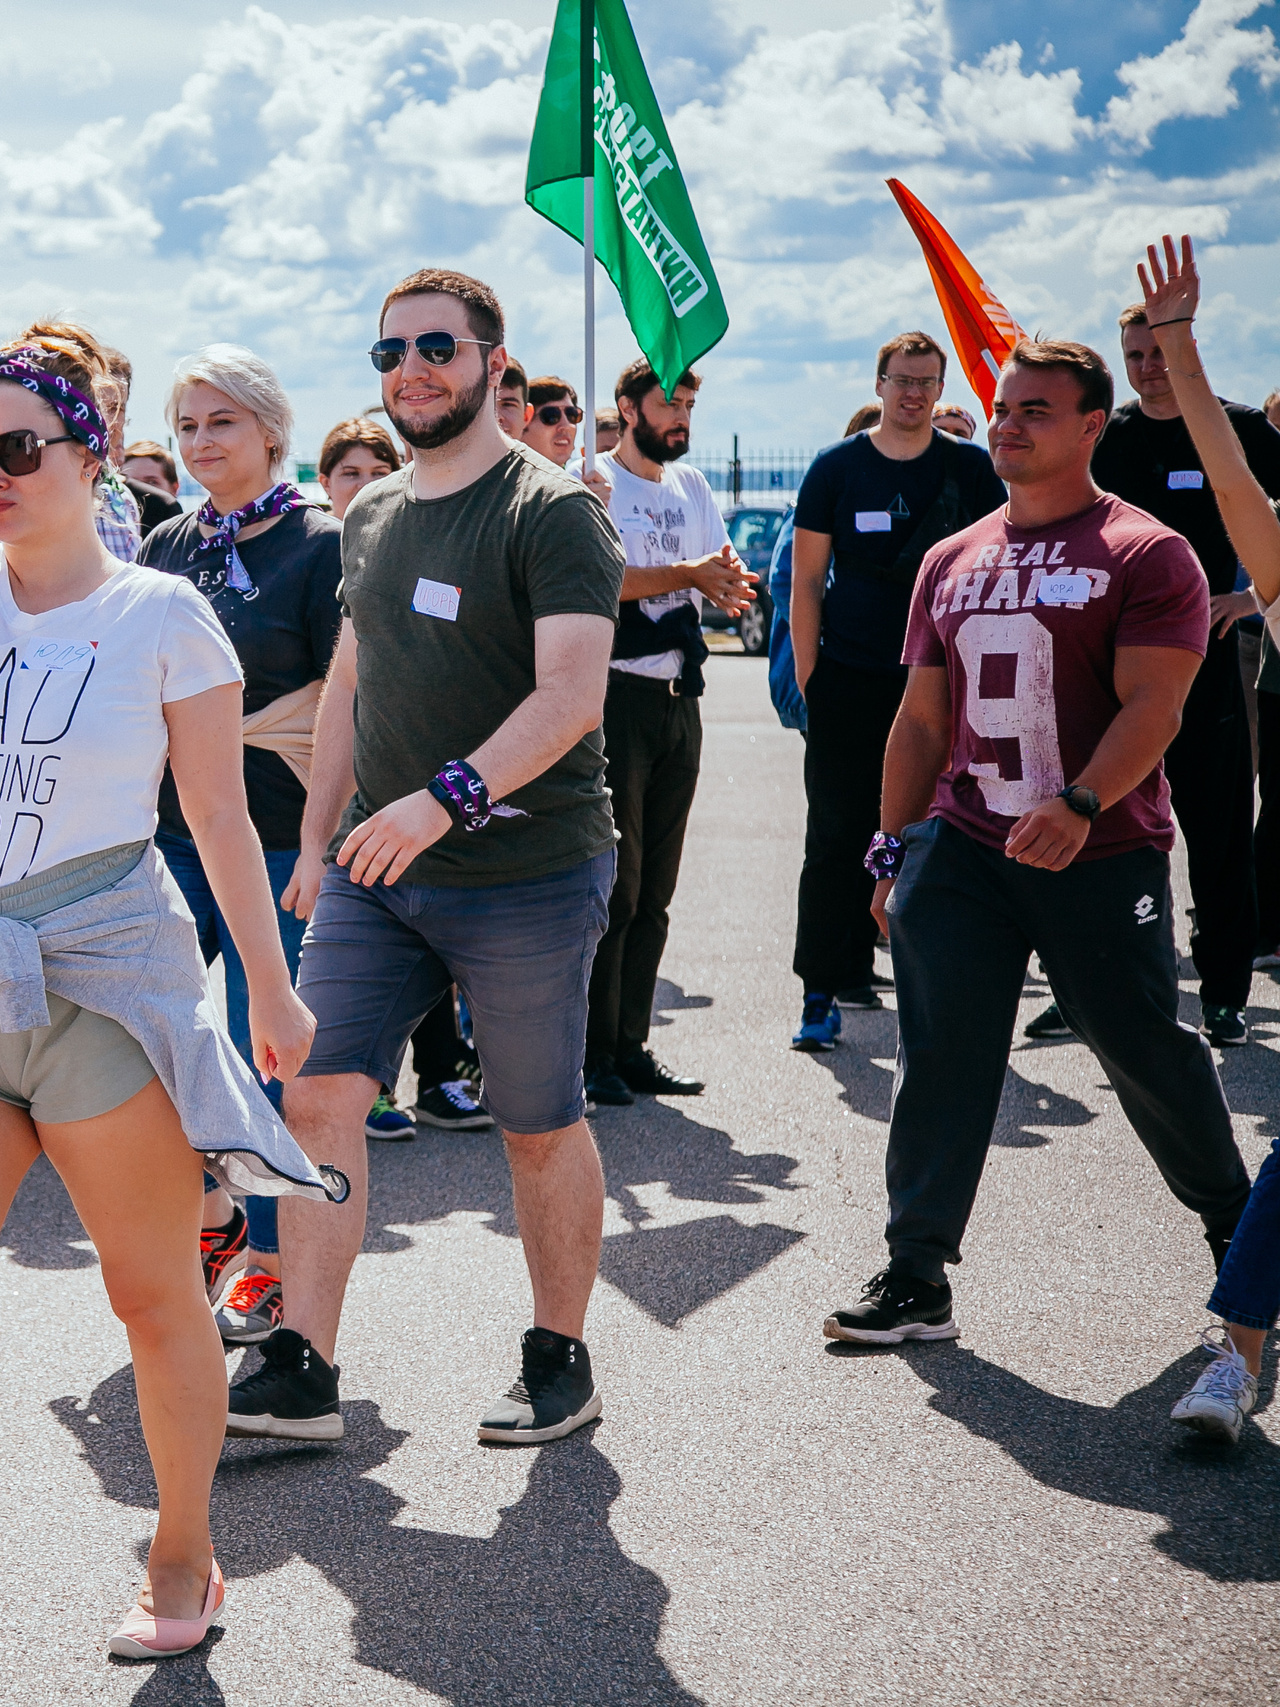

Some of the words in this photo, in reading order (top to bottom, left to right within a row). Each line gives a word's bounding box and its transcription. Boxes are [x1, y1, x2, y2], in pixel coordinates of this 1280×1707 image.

[972, 541, 1067, 569] REAL
[418, 586, 457, 613] ИГОРЬ
[1050, 583, 1074, 594] ЮРА
[33, 643, 91, 666] ЮЛЯ
[954, 612, 1065, 818] 9
